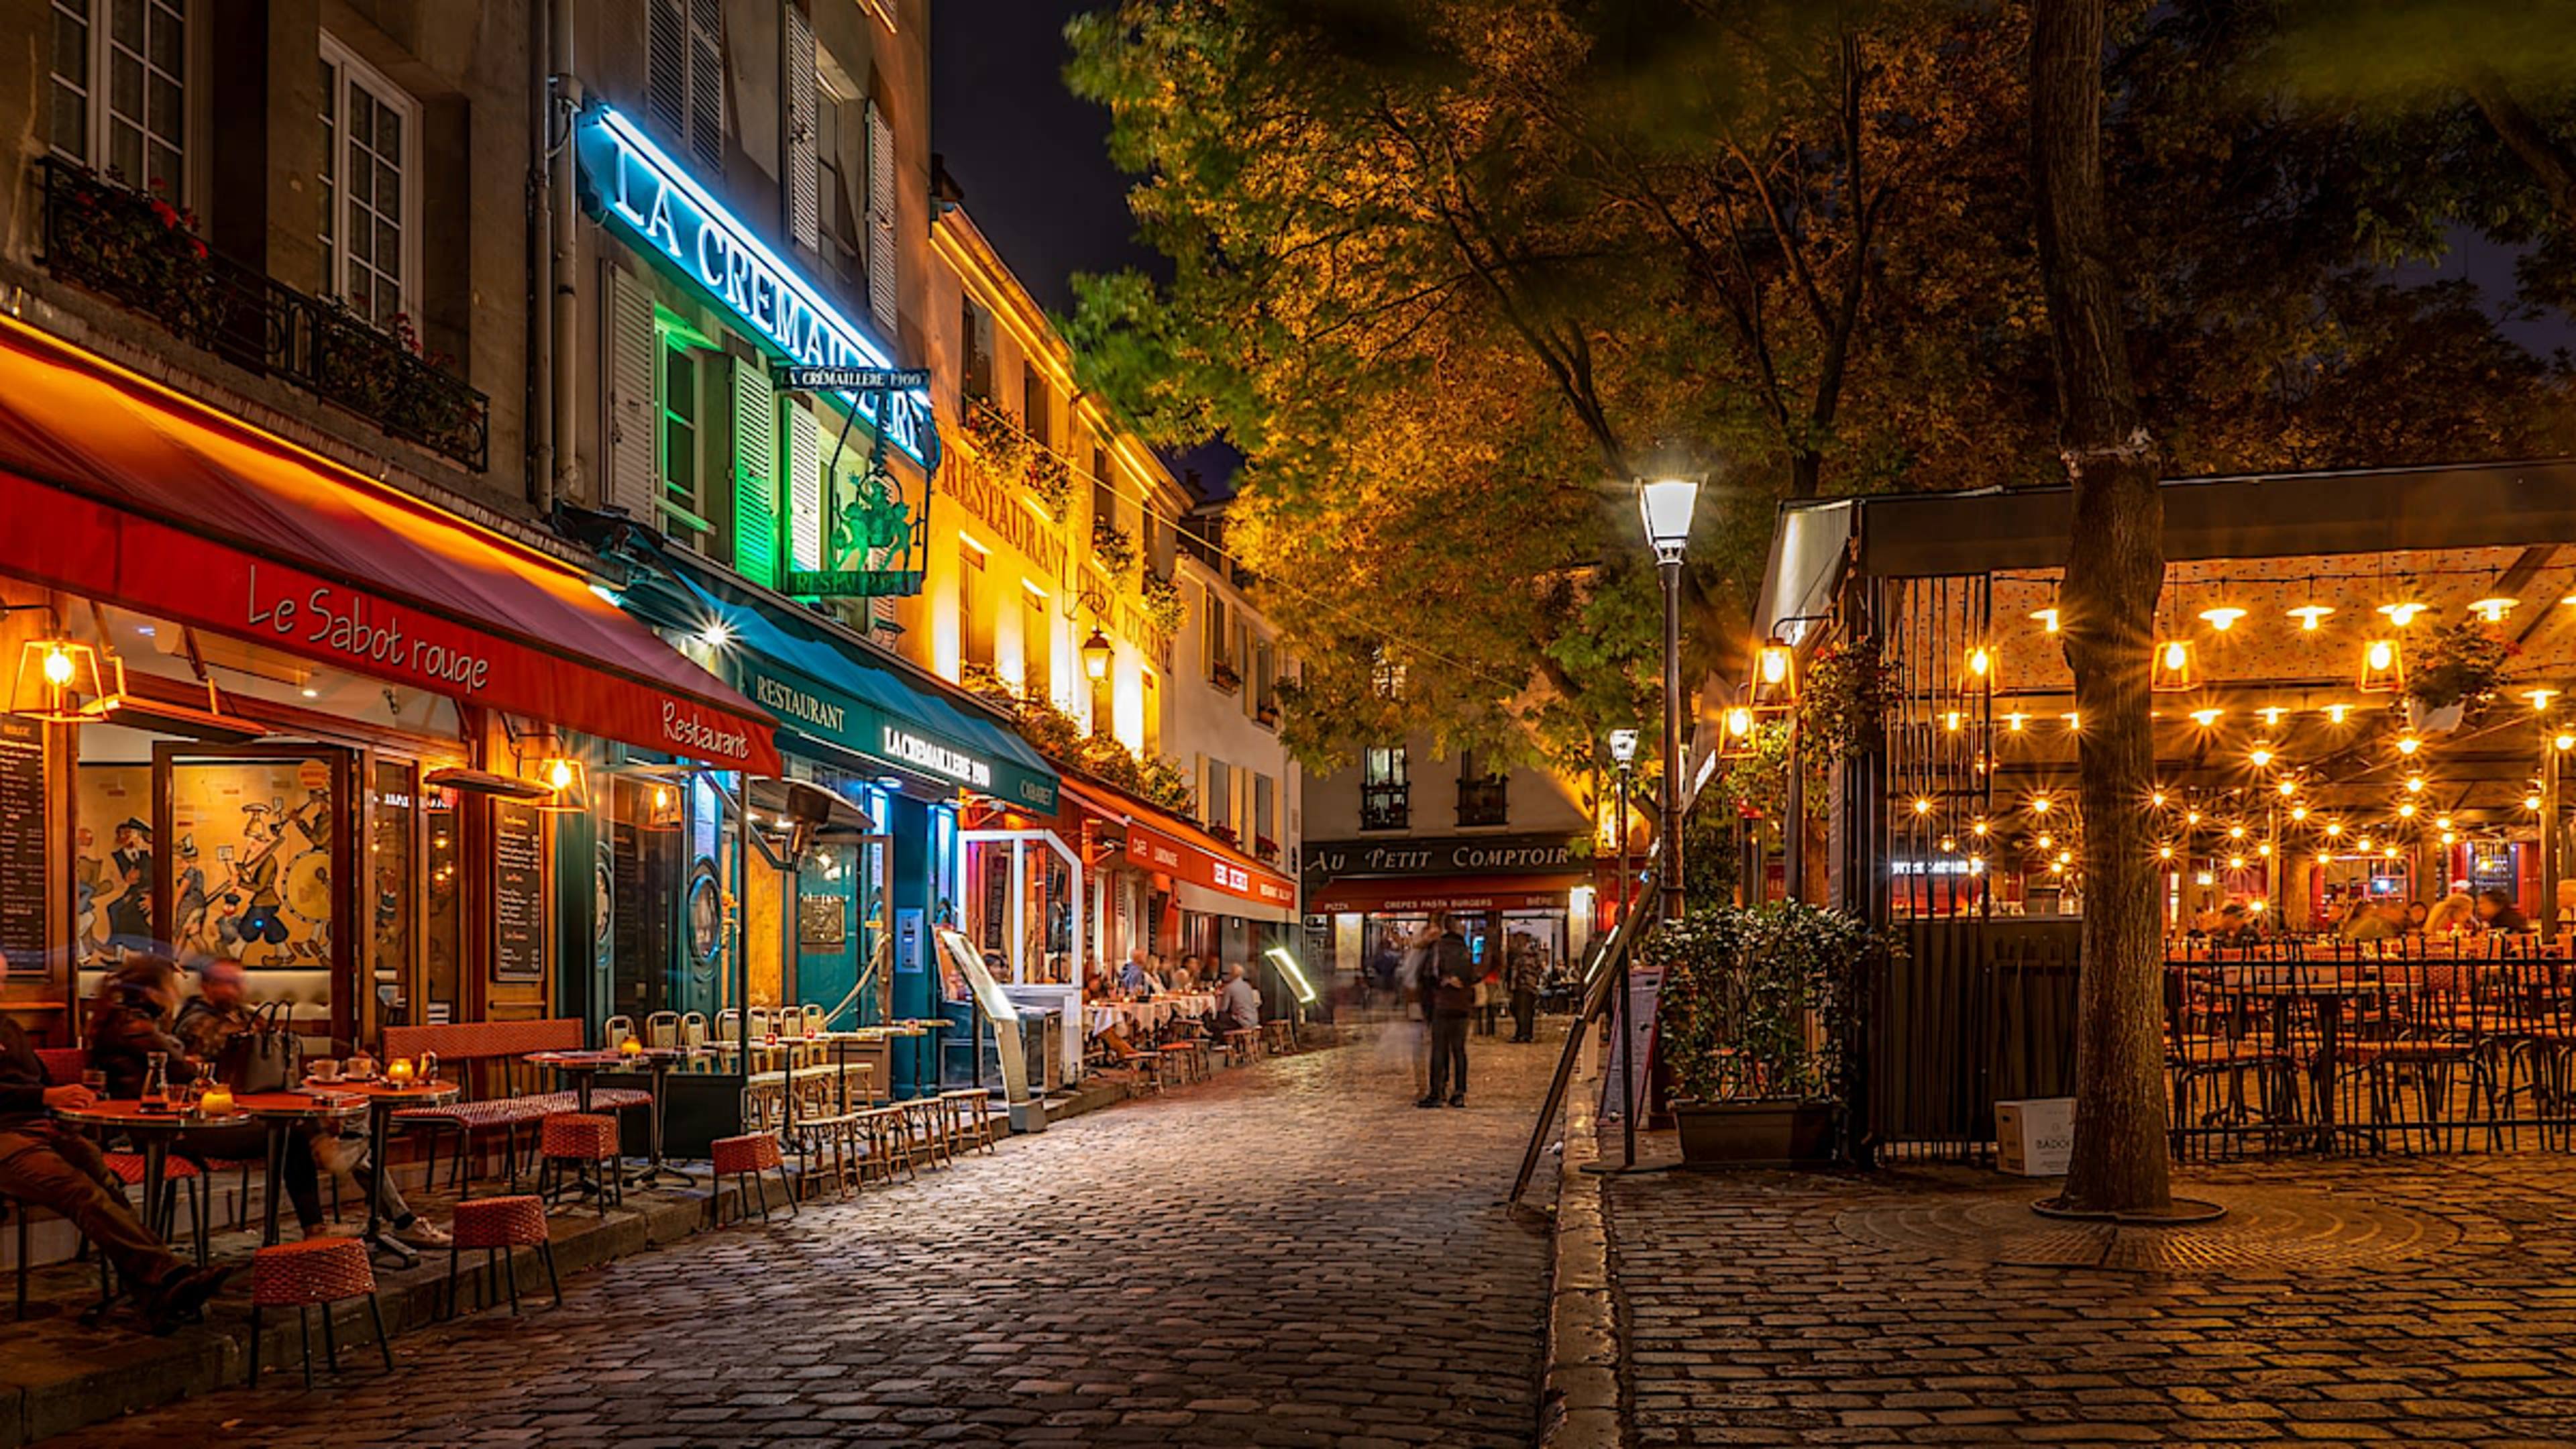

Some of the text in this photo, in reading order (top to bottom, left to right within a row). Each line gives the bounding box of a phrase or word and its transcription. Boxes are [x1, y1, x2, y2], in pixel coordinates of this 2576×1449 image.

[614, 143, 682, 258] LA
[943, 441, 1065, 580] RESTAURANT
[248, 564, 490, 695] Le Sabot rouge
[662, 700, 749, 759] Restaurant
[756, 674, 845, 733] RESTAURANT
[883, 726, 902, 757] LA
[1324, 902, 1350, 911] PIZZA
[1421, 899, 1448, 909] PASTA
[1450, 898, 1493, 908] BURGERS
